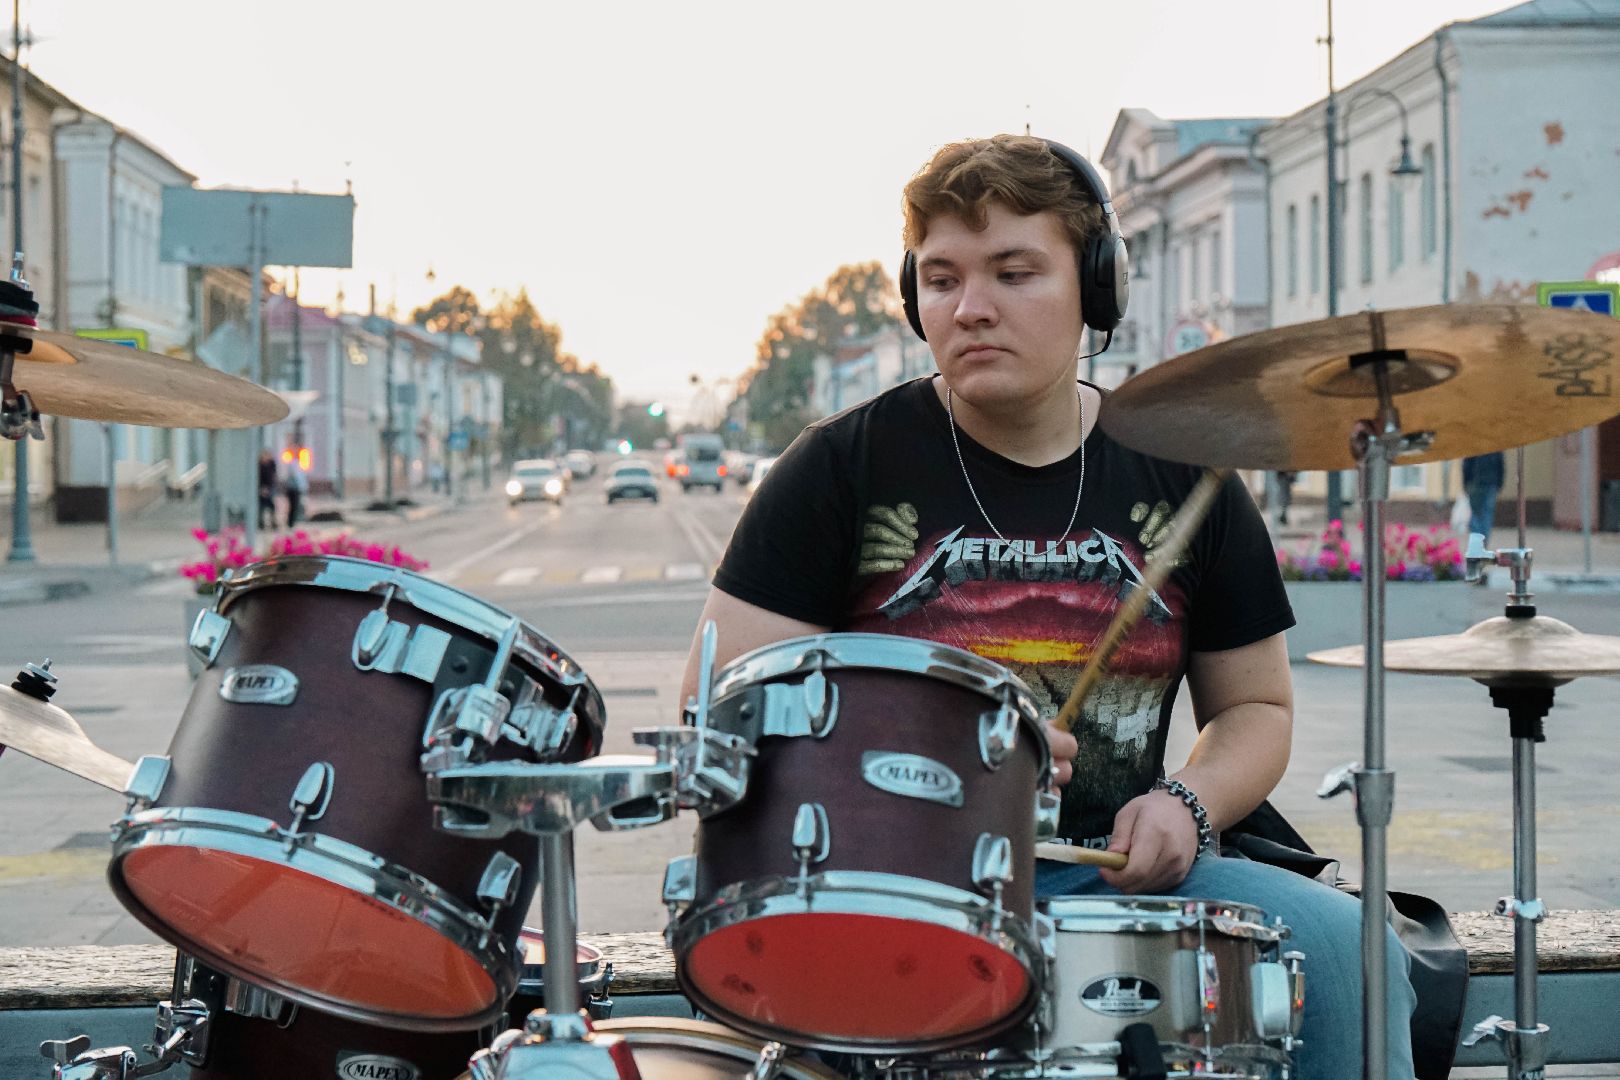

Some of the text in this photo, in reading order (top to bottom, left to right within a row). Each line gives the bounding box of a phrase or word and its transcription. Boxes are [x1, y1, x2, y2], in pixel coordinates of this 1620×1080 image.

[876, 524, 1174, 617] METALLICA
[886, 764, 940, 786] MAPEX
[353, 1063, 400, 1080] MAPEX
